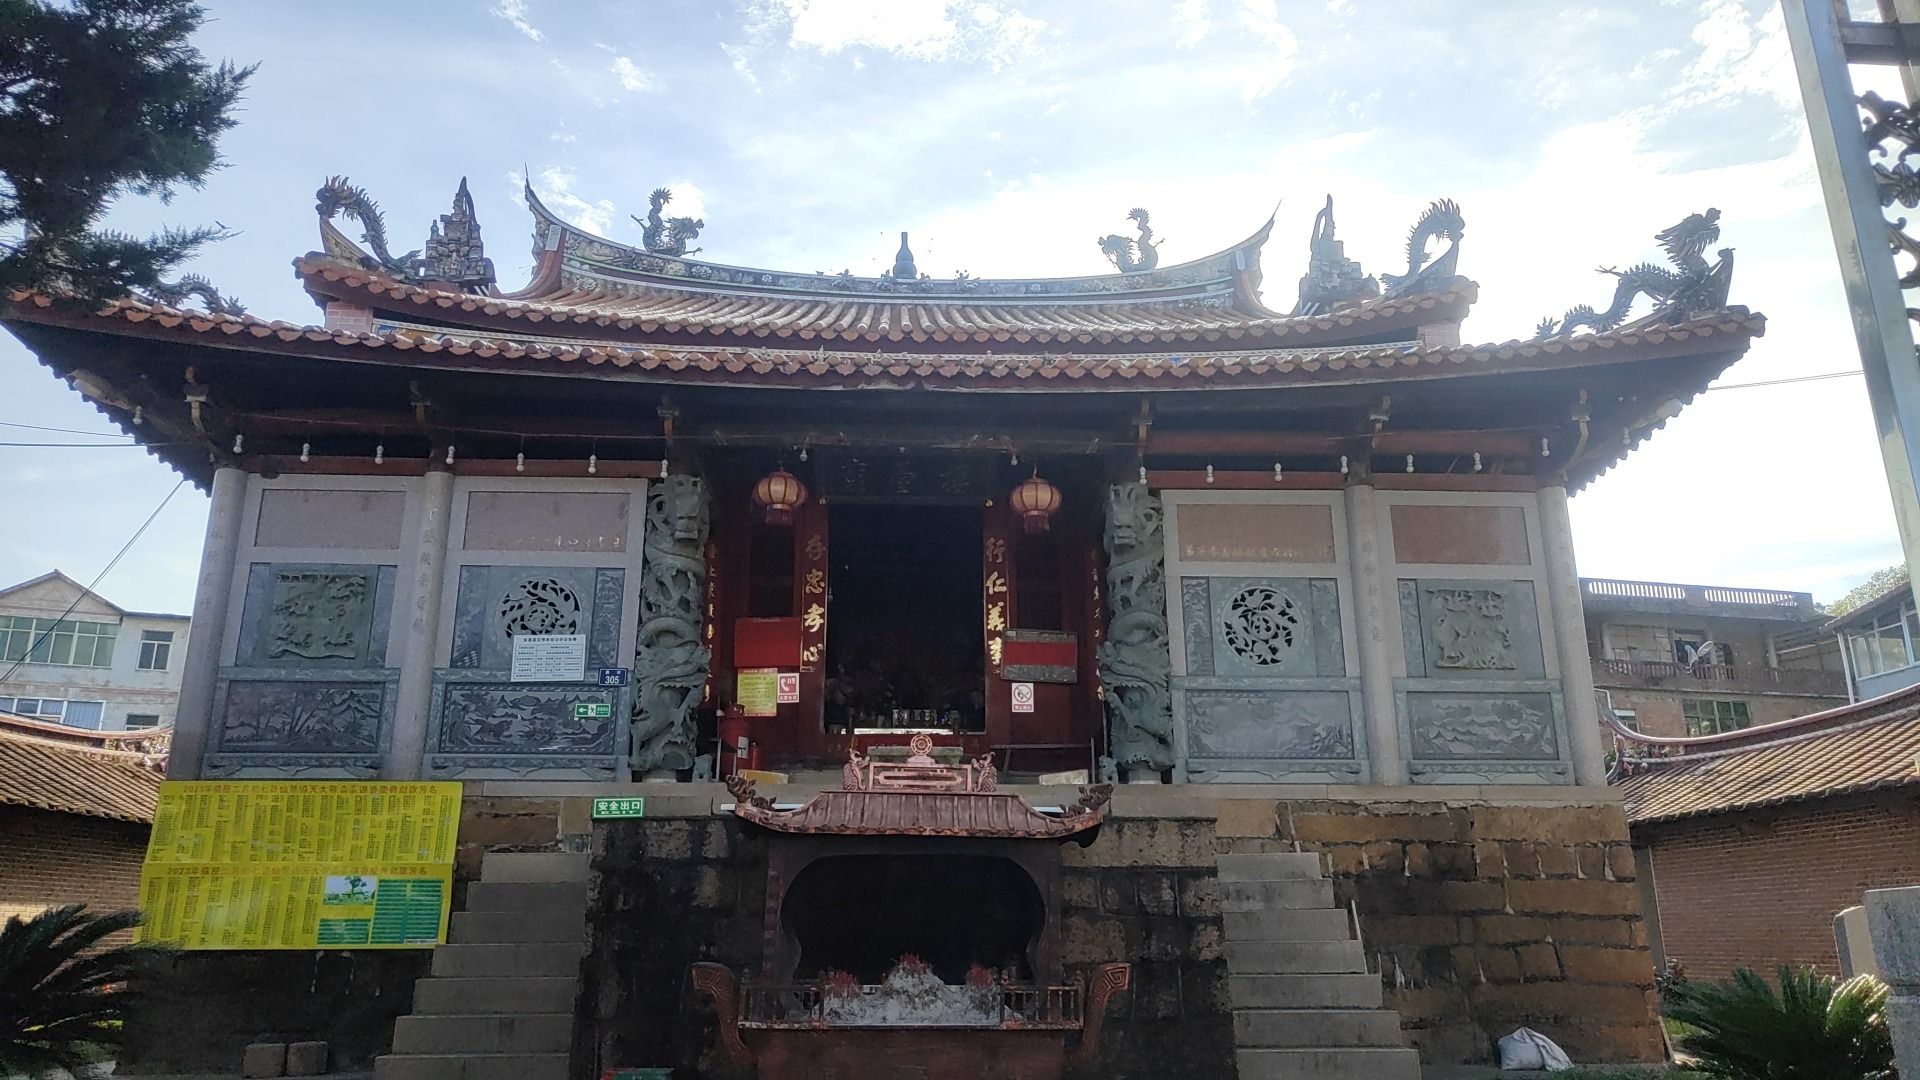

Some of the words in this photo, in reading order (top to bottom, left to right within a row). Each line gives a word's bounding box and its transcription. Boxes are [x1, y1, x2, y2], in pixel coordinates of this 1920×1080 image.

[804, 534, 826, 663] 存忠孝心
[605, 675, 620, 684] 305
[598, 801, 640, 811] 安全出口
